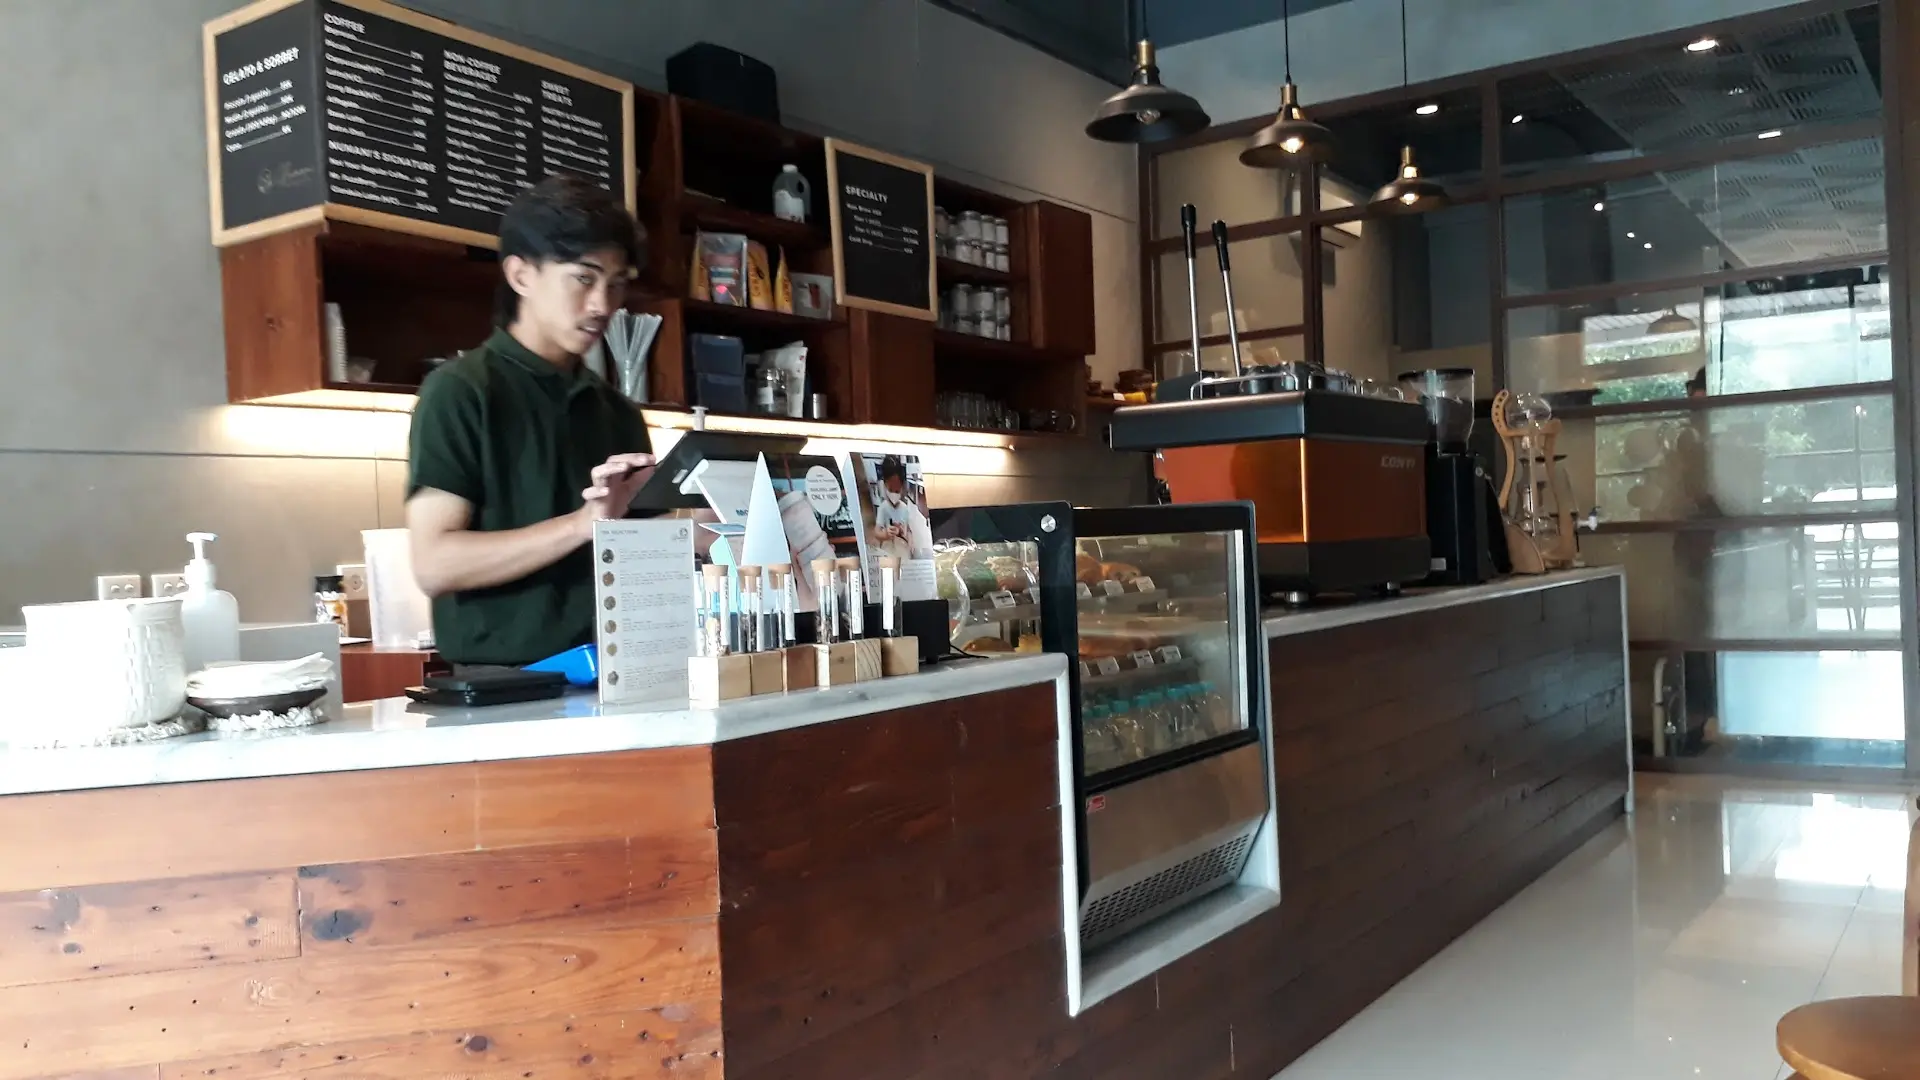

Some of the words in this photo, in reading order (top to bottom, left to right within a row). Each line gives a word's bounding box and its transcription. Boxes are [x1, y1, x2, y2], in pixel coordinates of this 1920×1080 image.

[323, 12, 365, 34] COFFEE
[223, 63, 257, 86] GELATO
[256, 60, 264, 73] &
[264, 46, 299, 71] SORBET
[443, 49, 502, 76] NON-COFFEE
[443, 60, 498, 84] BEVERAGES
[541, 80, 570, 97] SWEET
[541, 89, 573, 107] TREATS
[328, 139, 381, 161] NUMANI'S
[381, 151, 437, 174] SIGNATURE
[845, 184, 888, 204] SPECIALTY
[1380, 454, 1416, 469] CONTI
